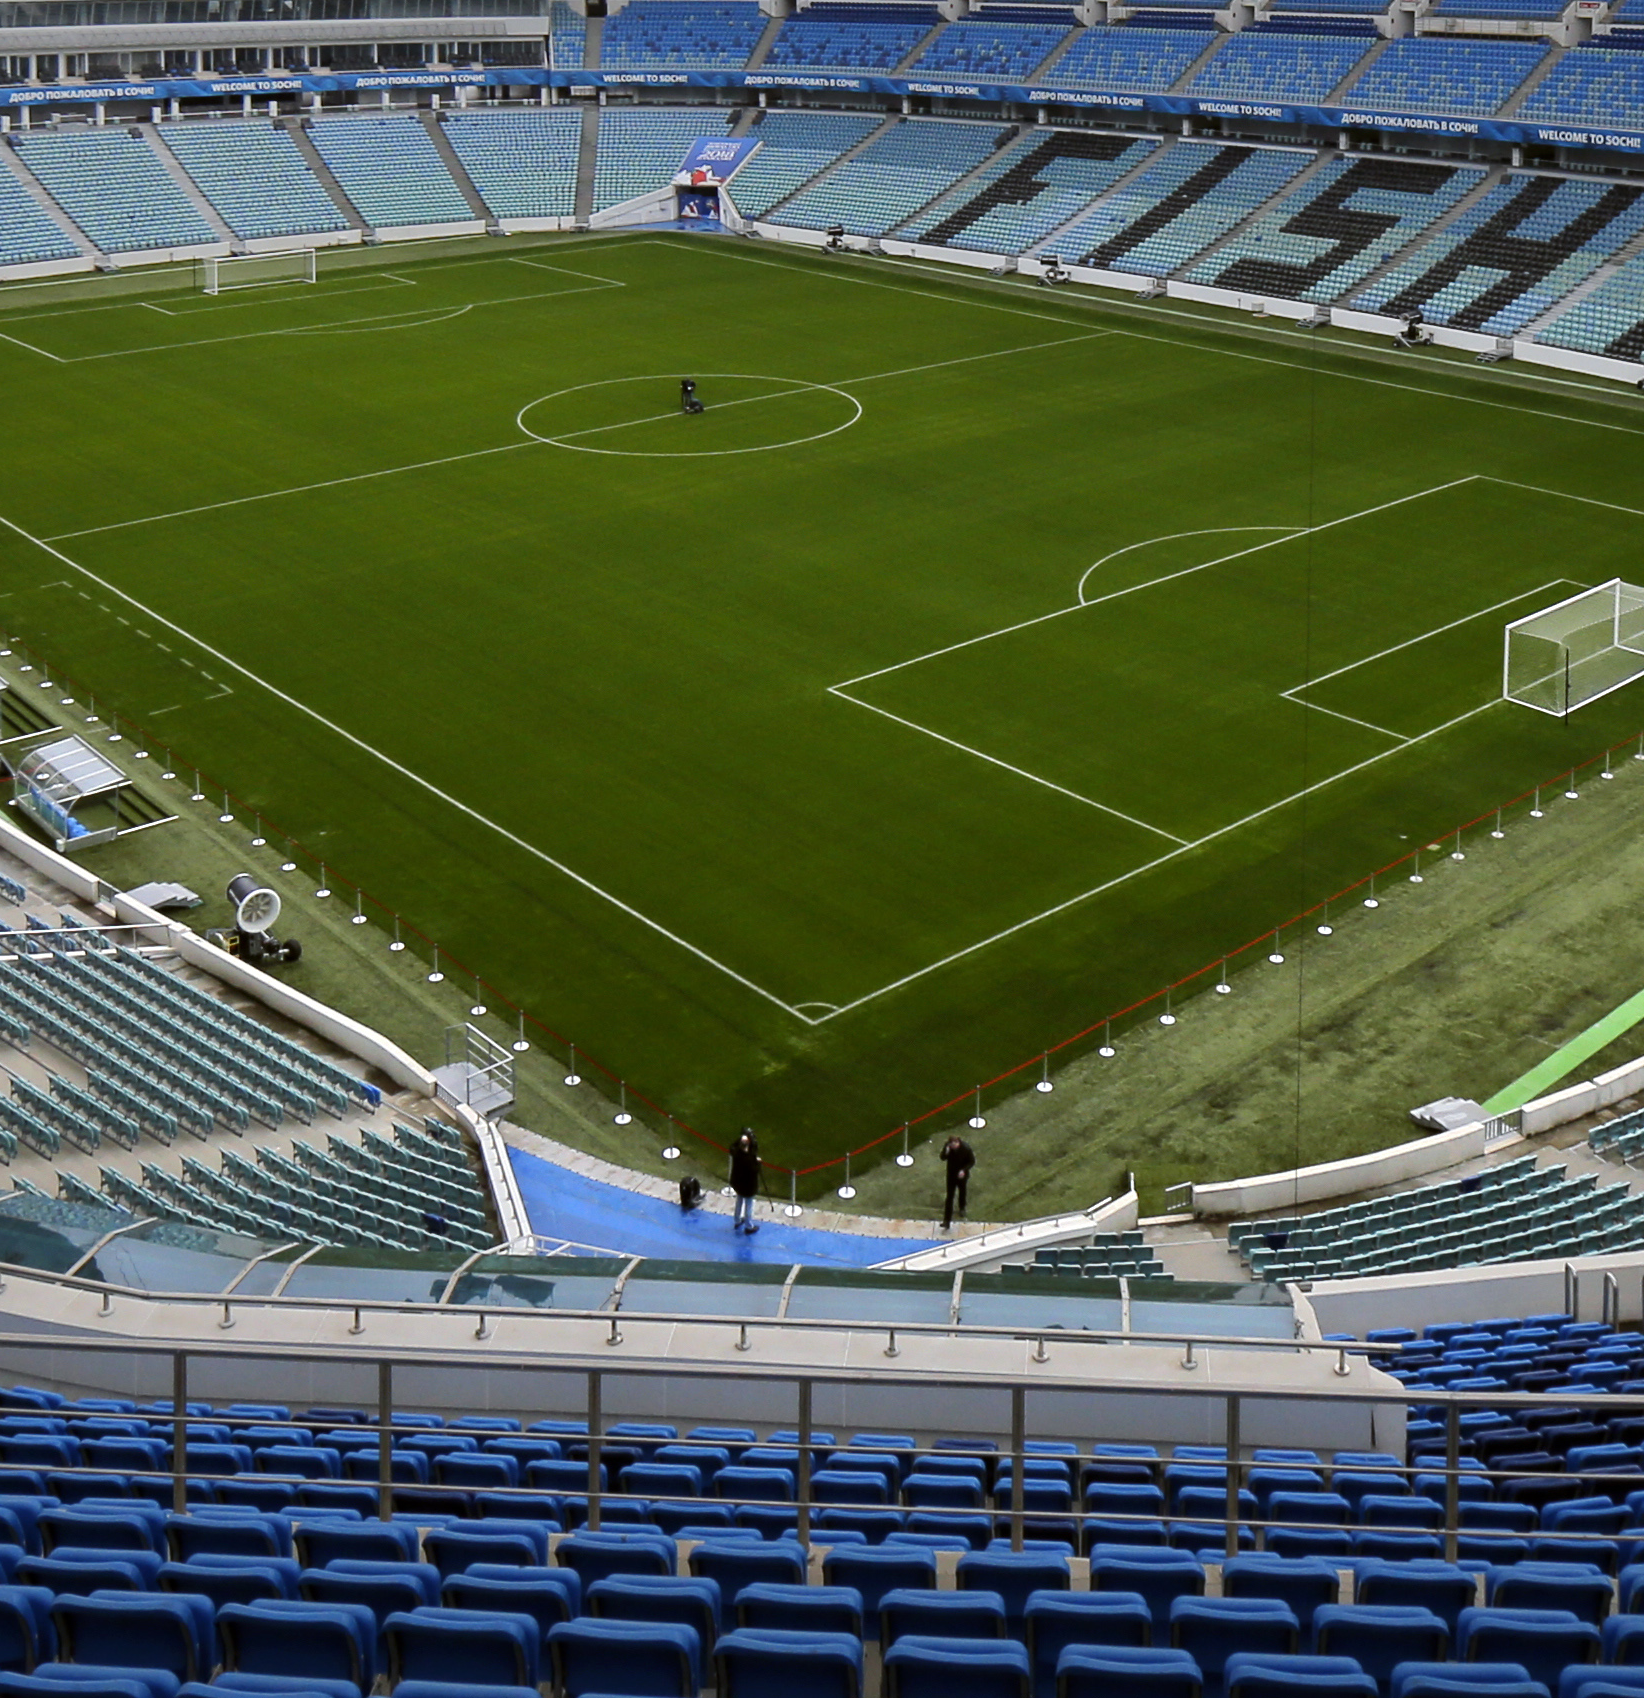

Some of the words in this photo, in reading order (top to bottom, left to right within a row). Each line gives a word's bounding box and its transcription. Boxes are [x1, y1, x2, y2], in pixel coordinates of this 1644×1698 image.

[211, 82, 257, 92] WELCOME
[258, 82, 271, 90] TO
[272, 81, 302, 89] SOCHI!
[356, 77, 388, 87] ДОБРО
[389, 76, 450, 85] ПОЖАЛОВАТЬ
[458, 75, 485, 83] СОЧИ!
[9, 92, 44, 103] ДОБРО
[46, 89, 116, 99] ПОЖАЛОВАТЬ
[117, 88, 123, 96] В
[125, 87, 154, 96] СОЧИ!
[1199, 103, 1239, 113] WELCOME
[1240, 105, 1251, 114] TO
[1253, 107, 1282, 117] SOCHI!
[1341, 113, 1373, 124] ДОБРО
[1375, 116, 1440, 130] ПОЖАЛОВАТЬ
[1441, 121, 1447, 130] В
[1449, 122, 1478, 133] СОЧИ!
[1539, 130, 1588, 143] WELCOME
[1590, 134, 1604, 144] TO
[1606, 135, 1641, 148] SOCHI!
